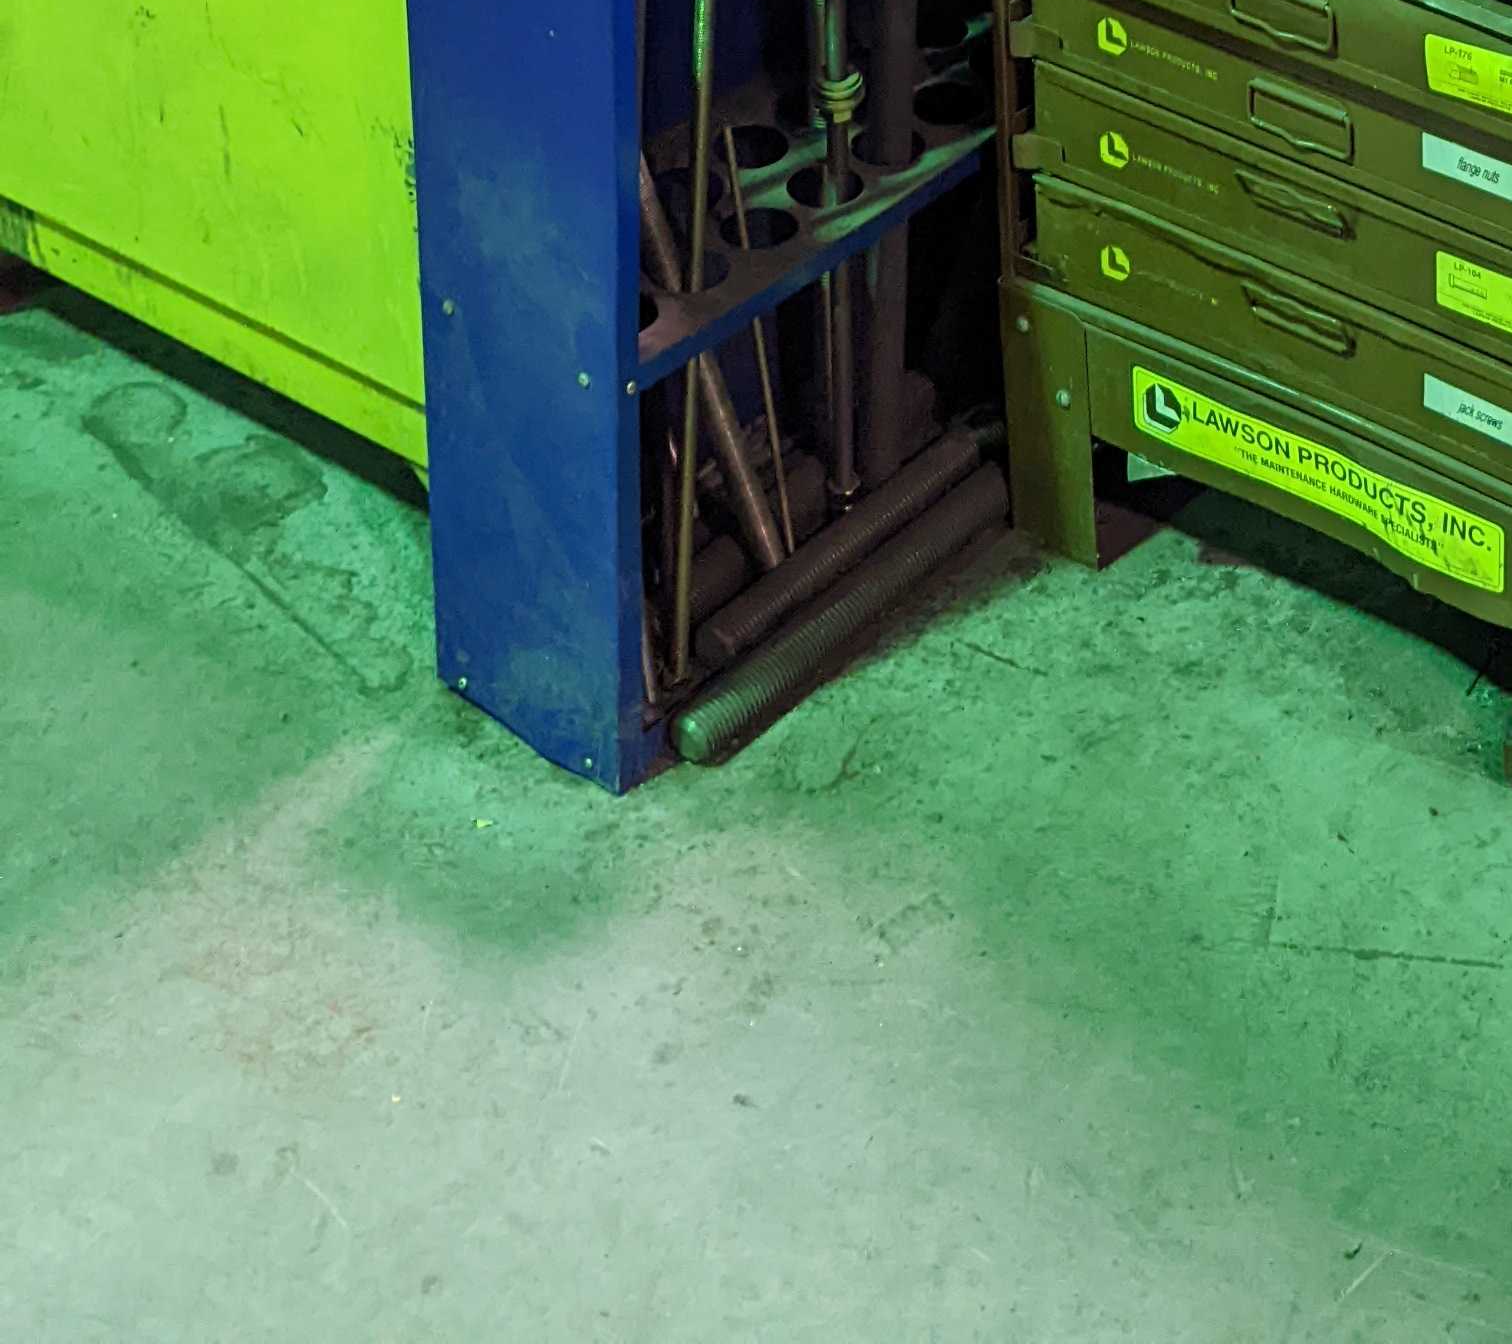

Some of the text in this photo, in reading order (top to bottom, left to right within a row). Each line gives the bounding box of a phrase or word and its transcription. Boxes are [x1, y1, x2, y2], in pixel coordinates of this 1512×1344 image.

[1457, 157, 1500, 184] flange nuts
[1192, 400, 1493, 552] LAWSON PRODUCTS, INC.
[1260, 456, 1328, 493] MAINTENANCE
[1329, 485, 1379, 521] HARDWARE
